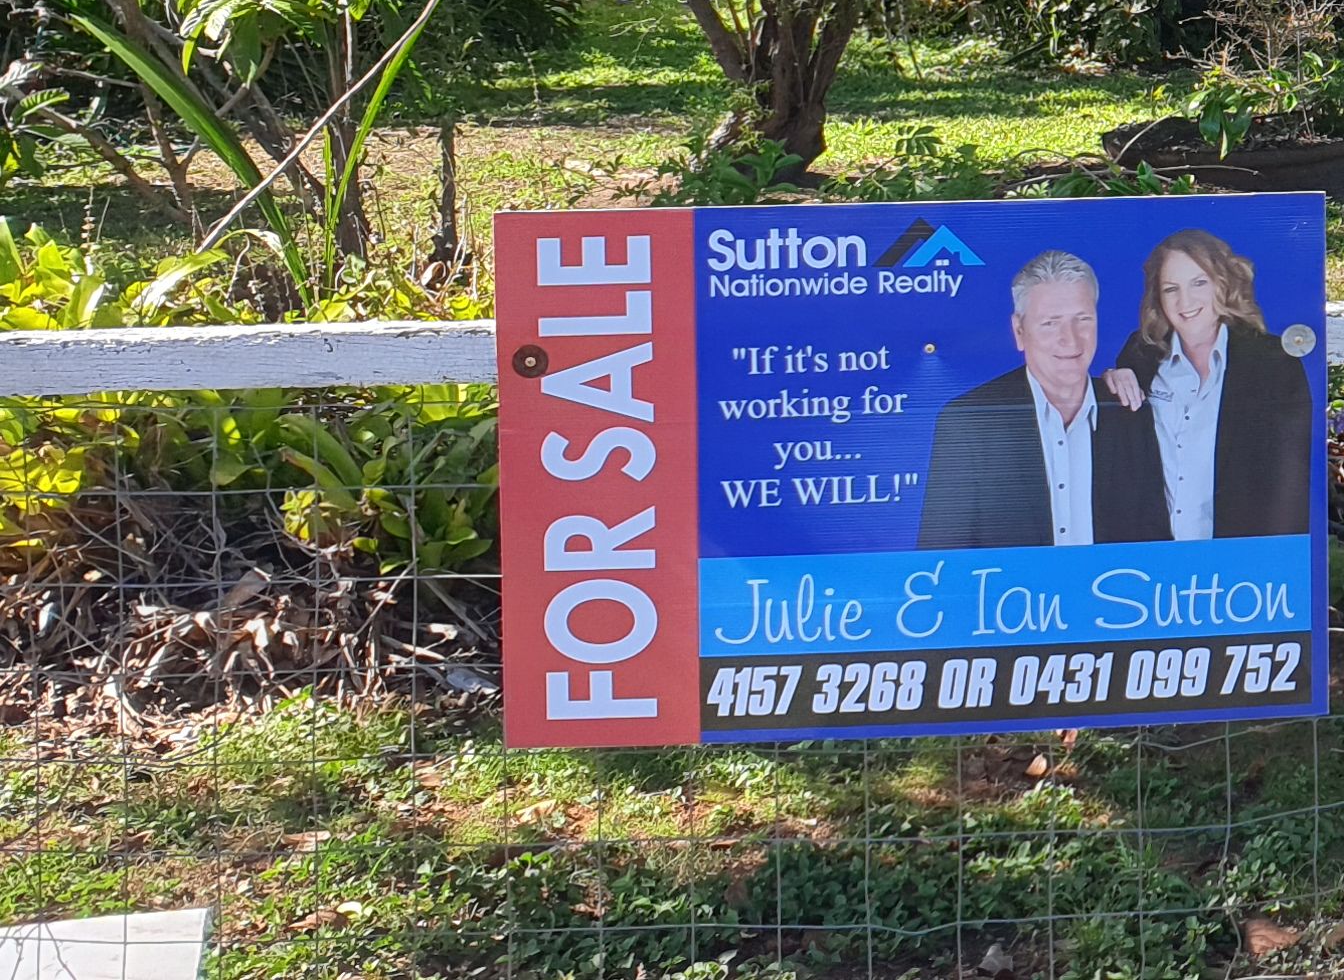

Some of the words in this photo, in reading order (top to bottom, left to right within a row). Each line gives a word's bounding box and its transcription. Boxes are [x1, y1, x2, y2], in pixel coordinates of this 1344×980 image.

[707, 227, 867, 271] Sutton
[710, 272, 868, 297] Nationwide
[878, 270, 963, 297] Realty
[536, 235, 657, 482] SALE
[732, 346, 779, 375] "If
[784, 345, 829, 373] it's
[838, 345, 890, 371] not
[718, 388, 851, 423] working
[861, 385, 908, 414] for
[773, 440, 862, 470] you...
[720, 479, 782, 509] WE
[791, 473, 919, 506] WILL!"
[543, 505, 658, 720] FOR
[714, 574, 872, 645] Julie
[897, 560, 944, 638] &
[971, 567, 1068, 636] Ian
[1091, 568, 1296, 629] Sutton
[706, 665, 802, 717] 4157
[811, 660, 927, 713] 3268
[937, 657, 997, 709] OR
[1008, 652, 1114, 706] 0431
[1124, 646, 1211, 700] 099
[1219, 642, 1302, 695] 752
